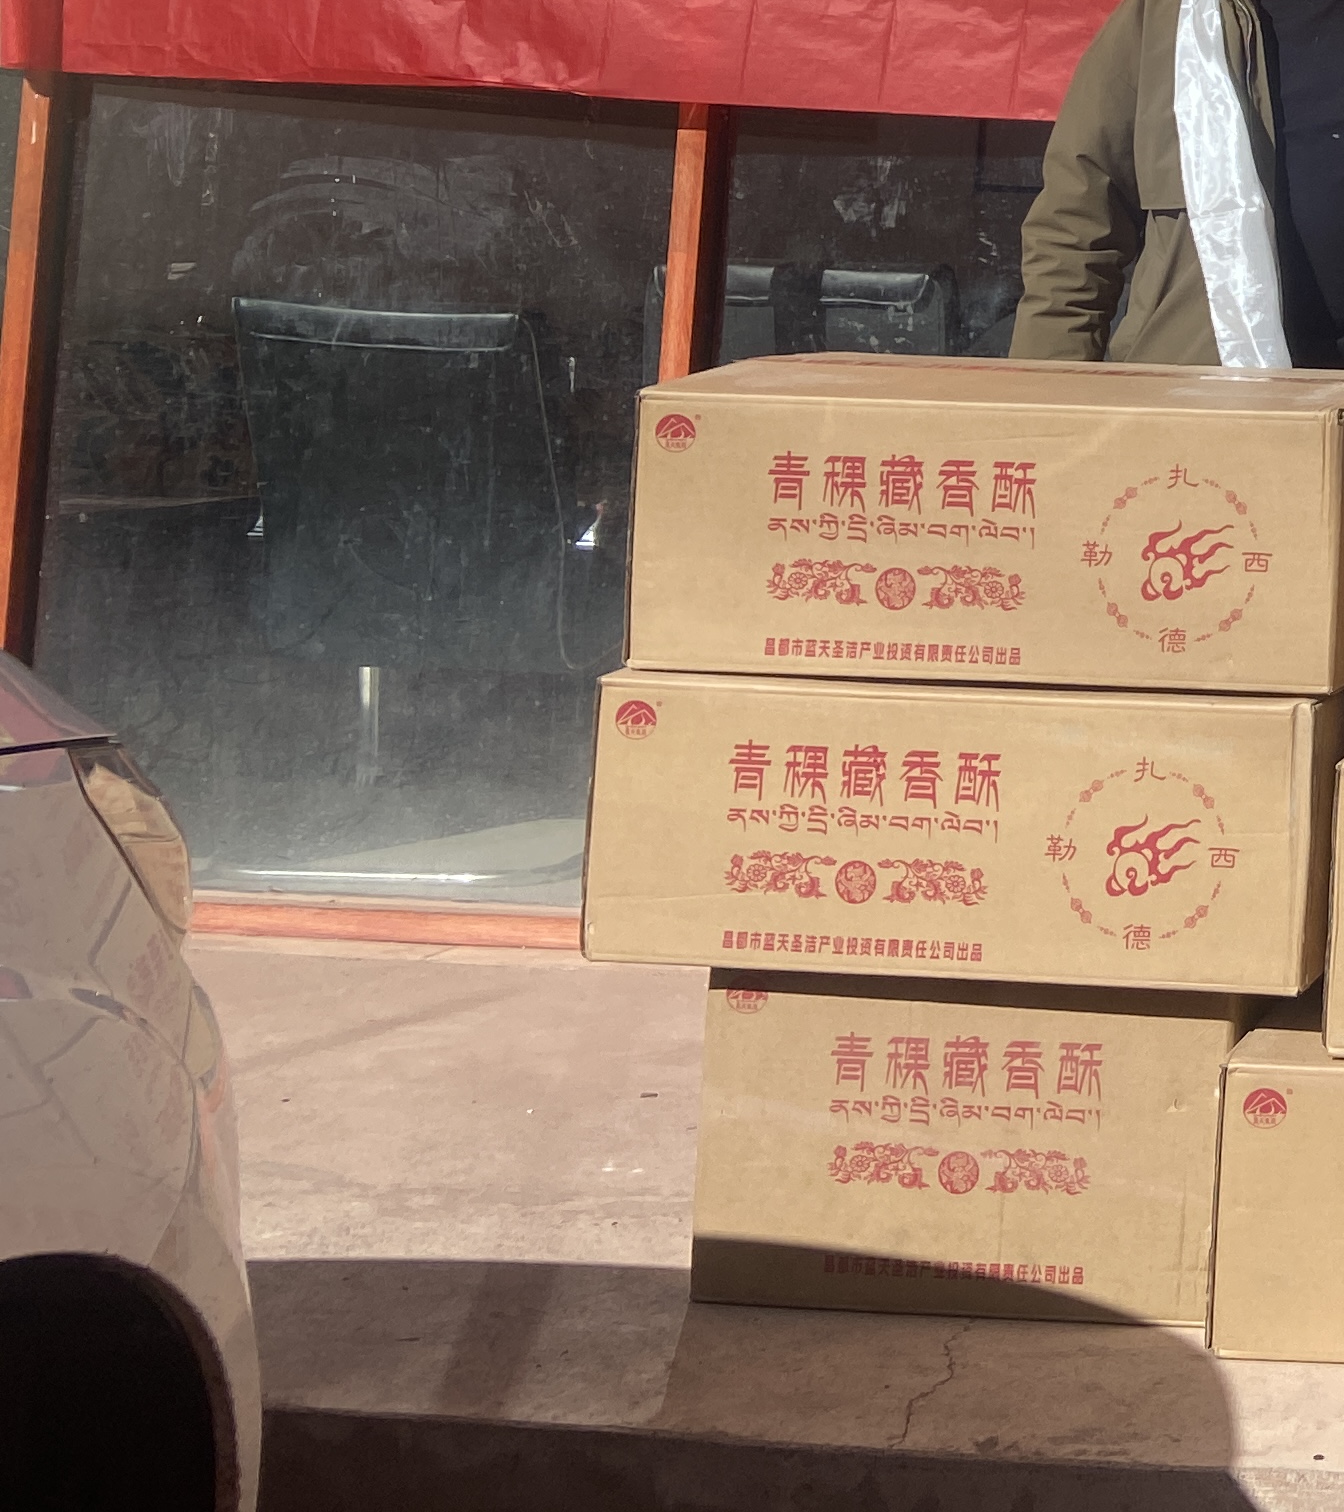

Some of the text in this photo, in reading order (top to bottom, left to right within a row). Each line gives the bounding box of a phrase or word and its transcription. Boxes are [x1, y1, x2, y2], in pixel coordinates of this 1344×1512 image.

[769, 451, 1036, 519] 青稞藏香酥
[1081, 464, 1272, 654] 扎 西 德 勒
[765, 638, 1020, 665] 昌都市蓝天圣洁产业投资有限责任公司出品
[730, 740, 1000, 811] 青稞藏香酥
[1045, 760, 1240, 951] 扎 西 德 勒
[722, 930, 982, 962] 昌都市蓝天圣洁产业投资有限责任公司出品
[832, 1035, 1102, 1099] 青稞藏香酥
